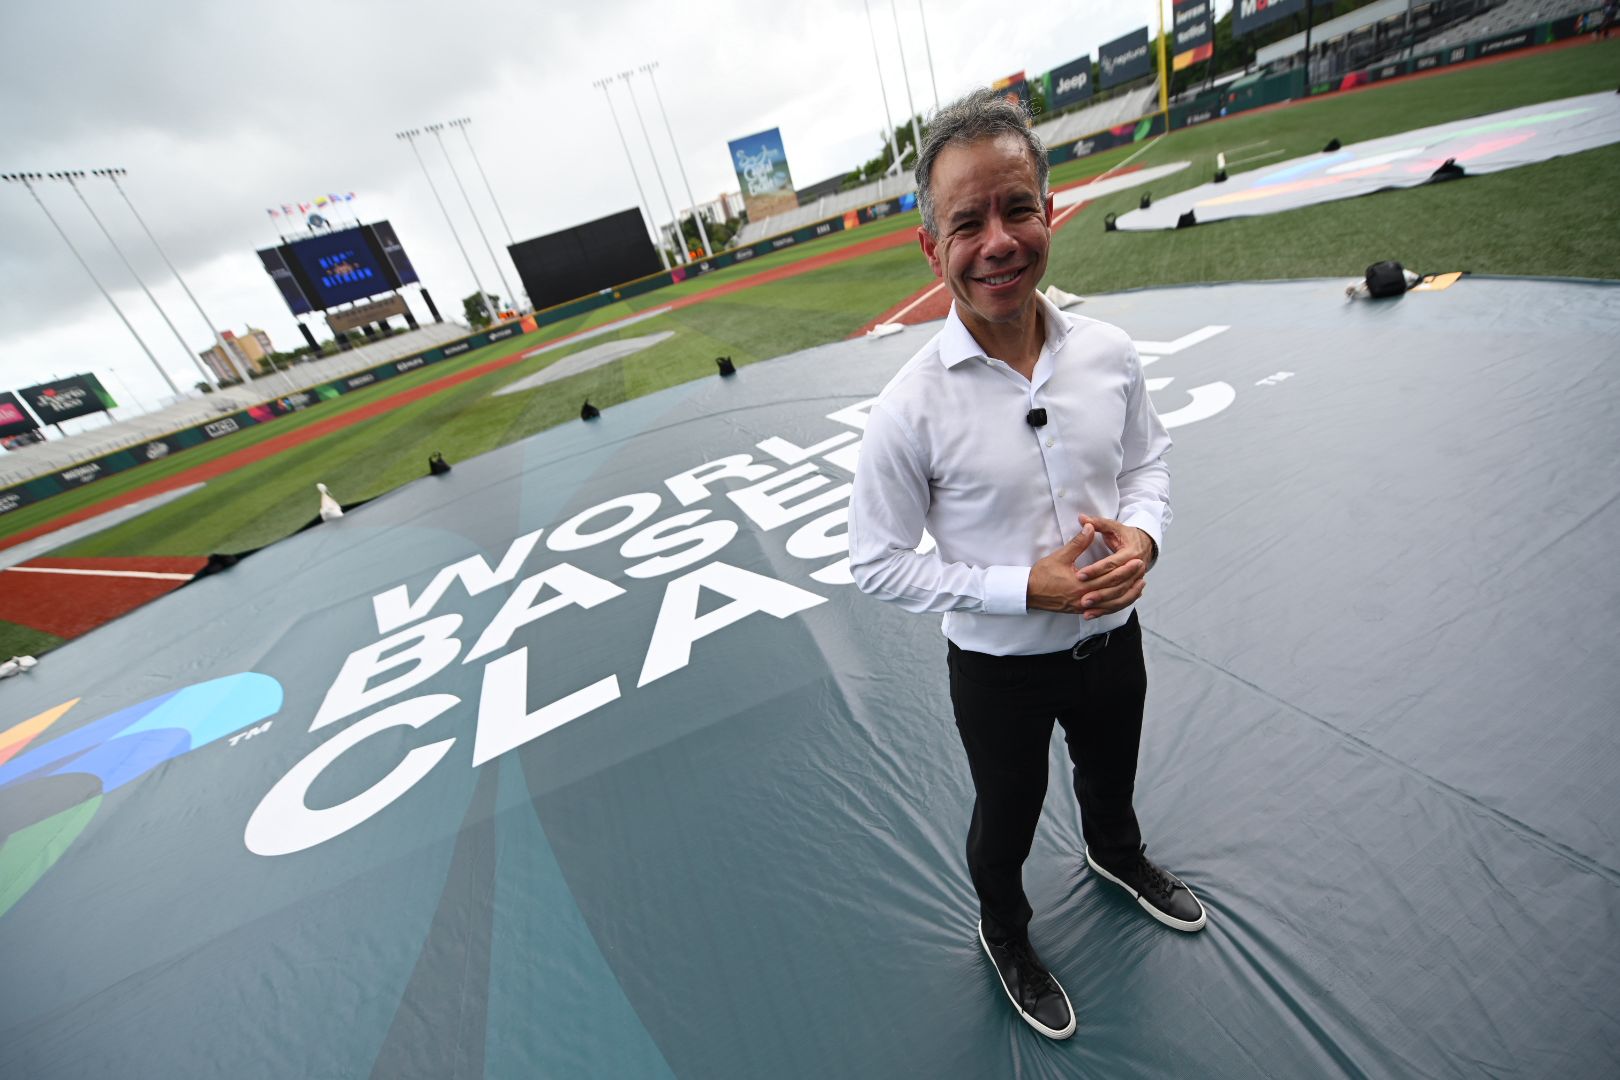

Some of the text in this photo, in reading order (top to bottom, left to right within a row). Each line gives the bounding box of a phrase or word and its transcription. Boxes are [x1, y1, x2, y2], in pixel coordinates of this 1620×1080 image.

[1056, 72, 1087, 95] Jeep
[1255, 371, 1295, 387] TM
[228, 721, 273, 747] TM
